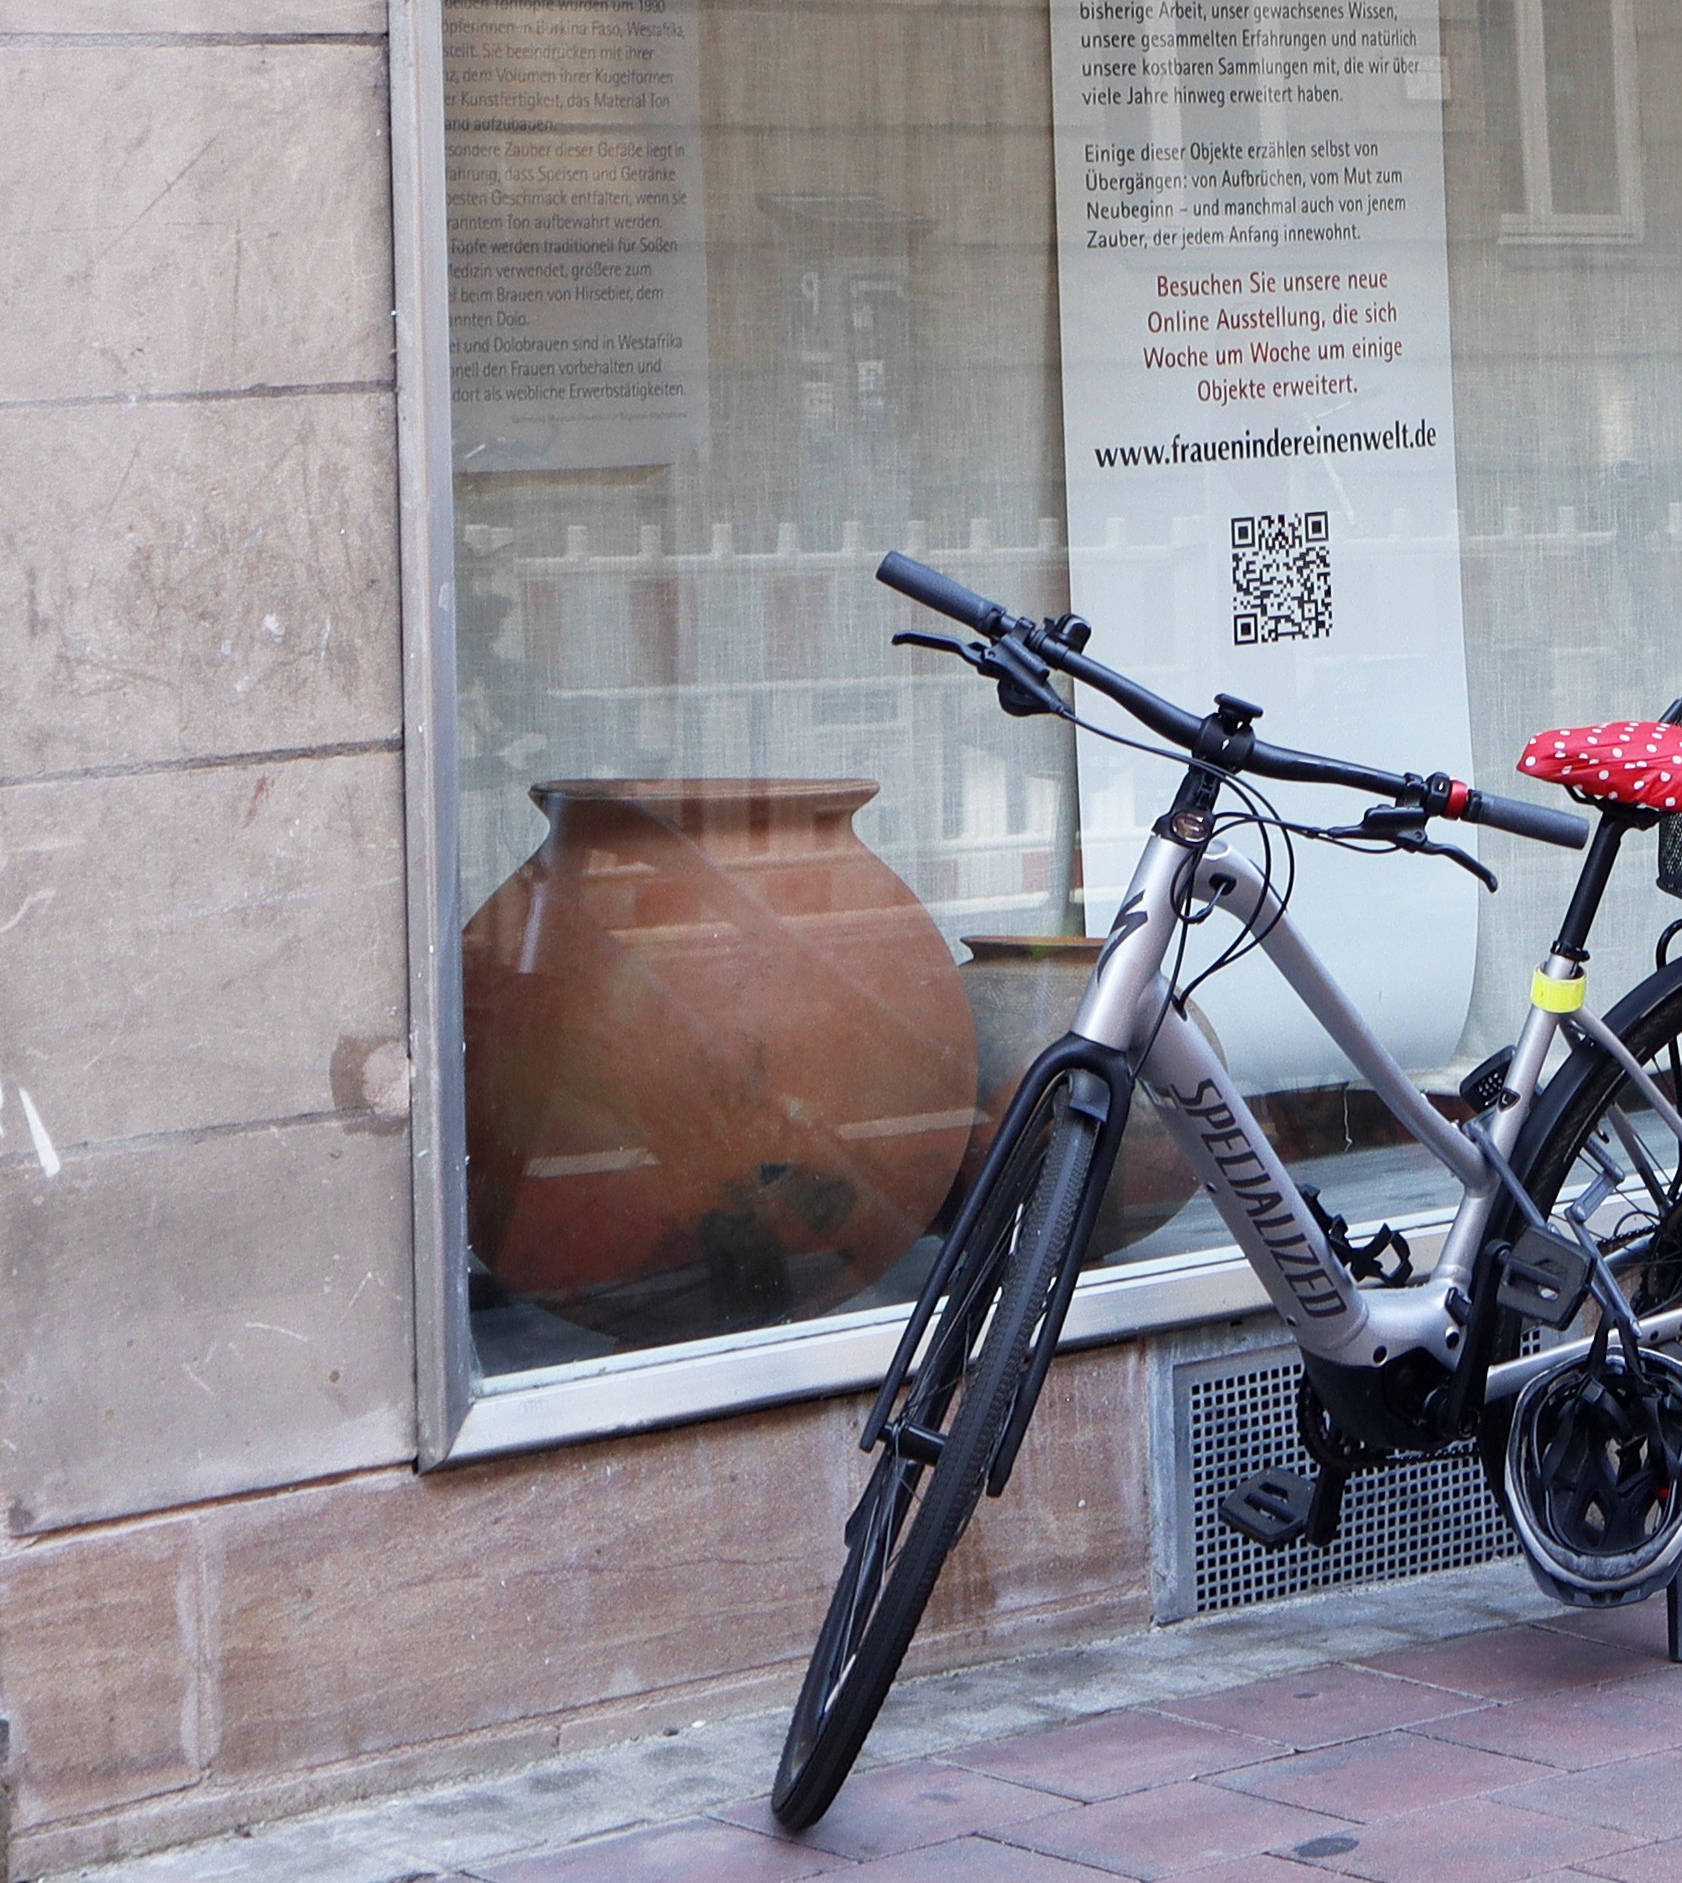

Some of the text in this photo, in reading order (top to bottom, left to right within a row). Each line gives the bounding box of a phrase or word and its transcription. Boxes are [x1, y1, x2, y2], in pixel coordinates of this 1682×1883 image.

[1080, 2, 1397, 23] bisherige Arbeit, unser gewachsenes Wissen,
[1082, 86, 1343, 107] viele Jahre hinweg erweitert haben.
[1085, 141, 1378, 166] Einige dieser Objekte erzählen selbst von
[1086, 167, 1402, 194] Übergängen: von Aufbrüchen, vom Mut zum
[1087, 224, 1360, 250] Zauber, der jedem Anfang innewohnt.
[1157, 273, 1388, 297] Besuchen Sie unsere neue
[1148, 302, 1397, 334] Online Ausstellung, die sich
[1144, 338, 1402, 369] Woche um Woche um einige
[1198, 376, 1358, 406] Objekte erweitert.
[1095, 419, 1437, 468] www.frauenindereinenwelt.de
[1170, 1078, 1347, 1318] SPECIALIZED
